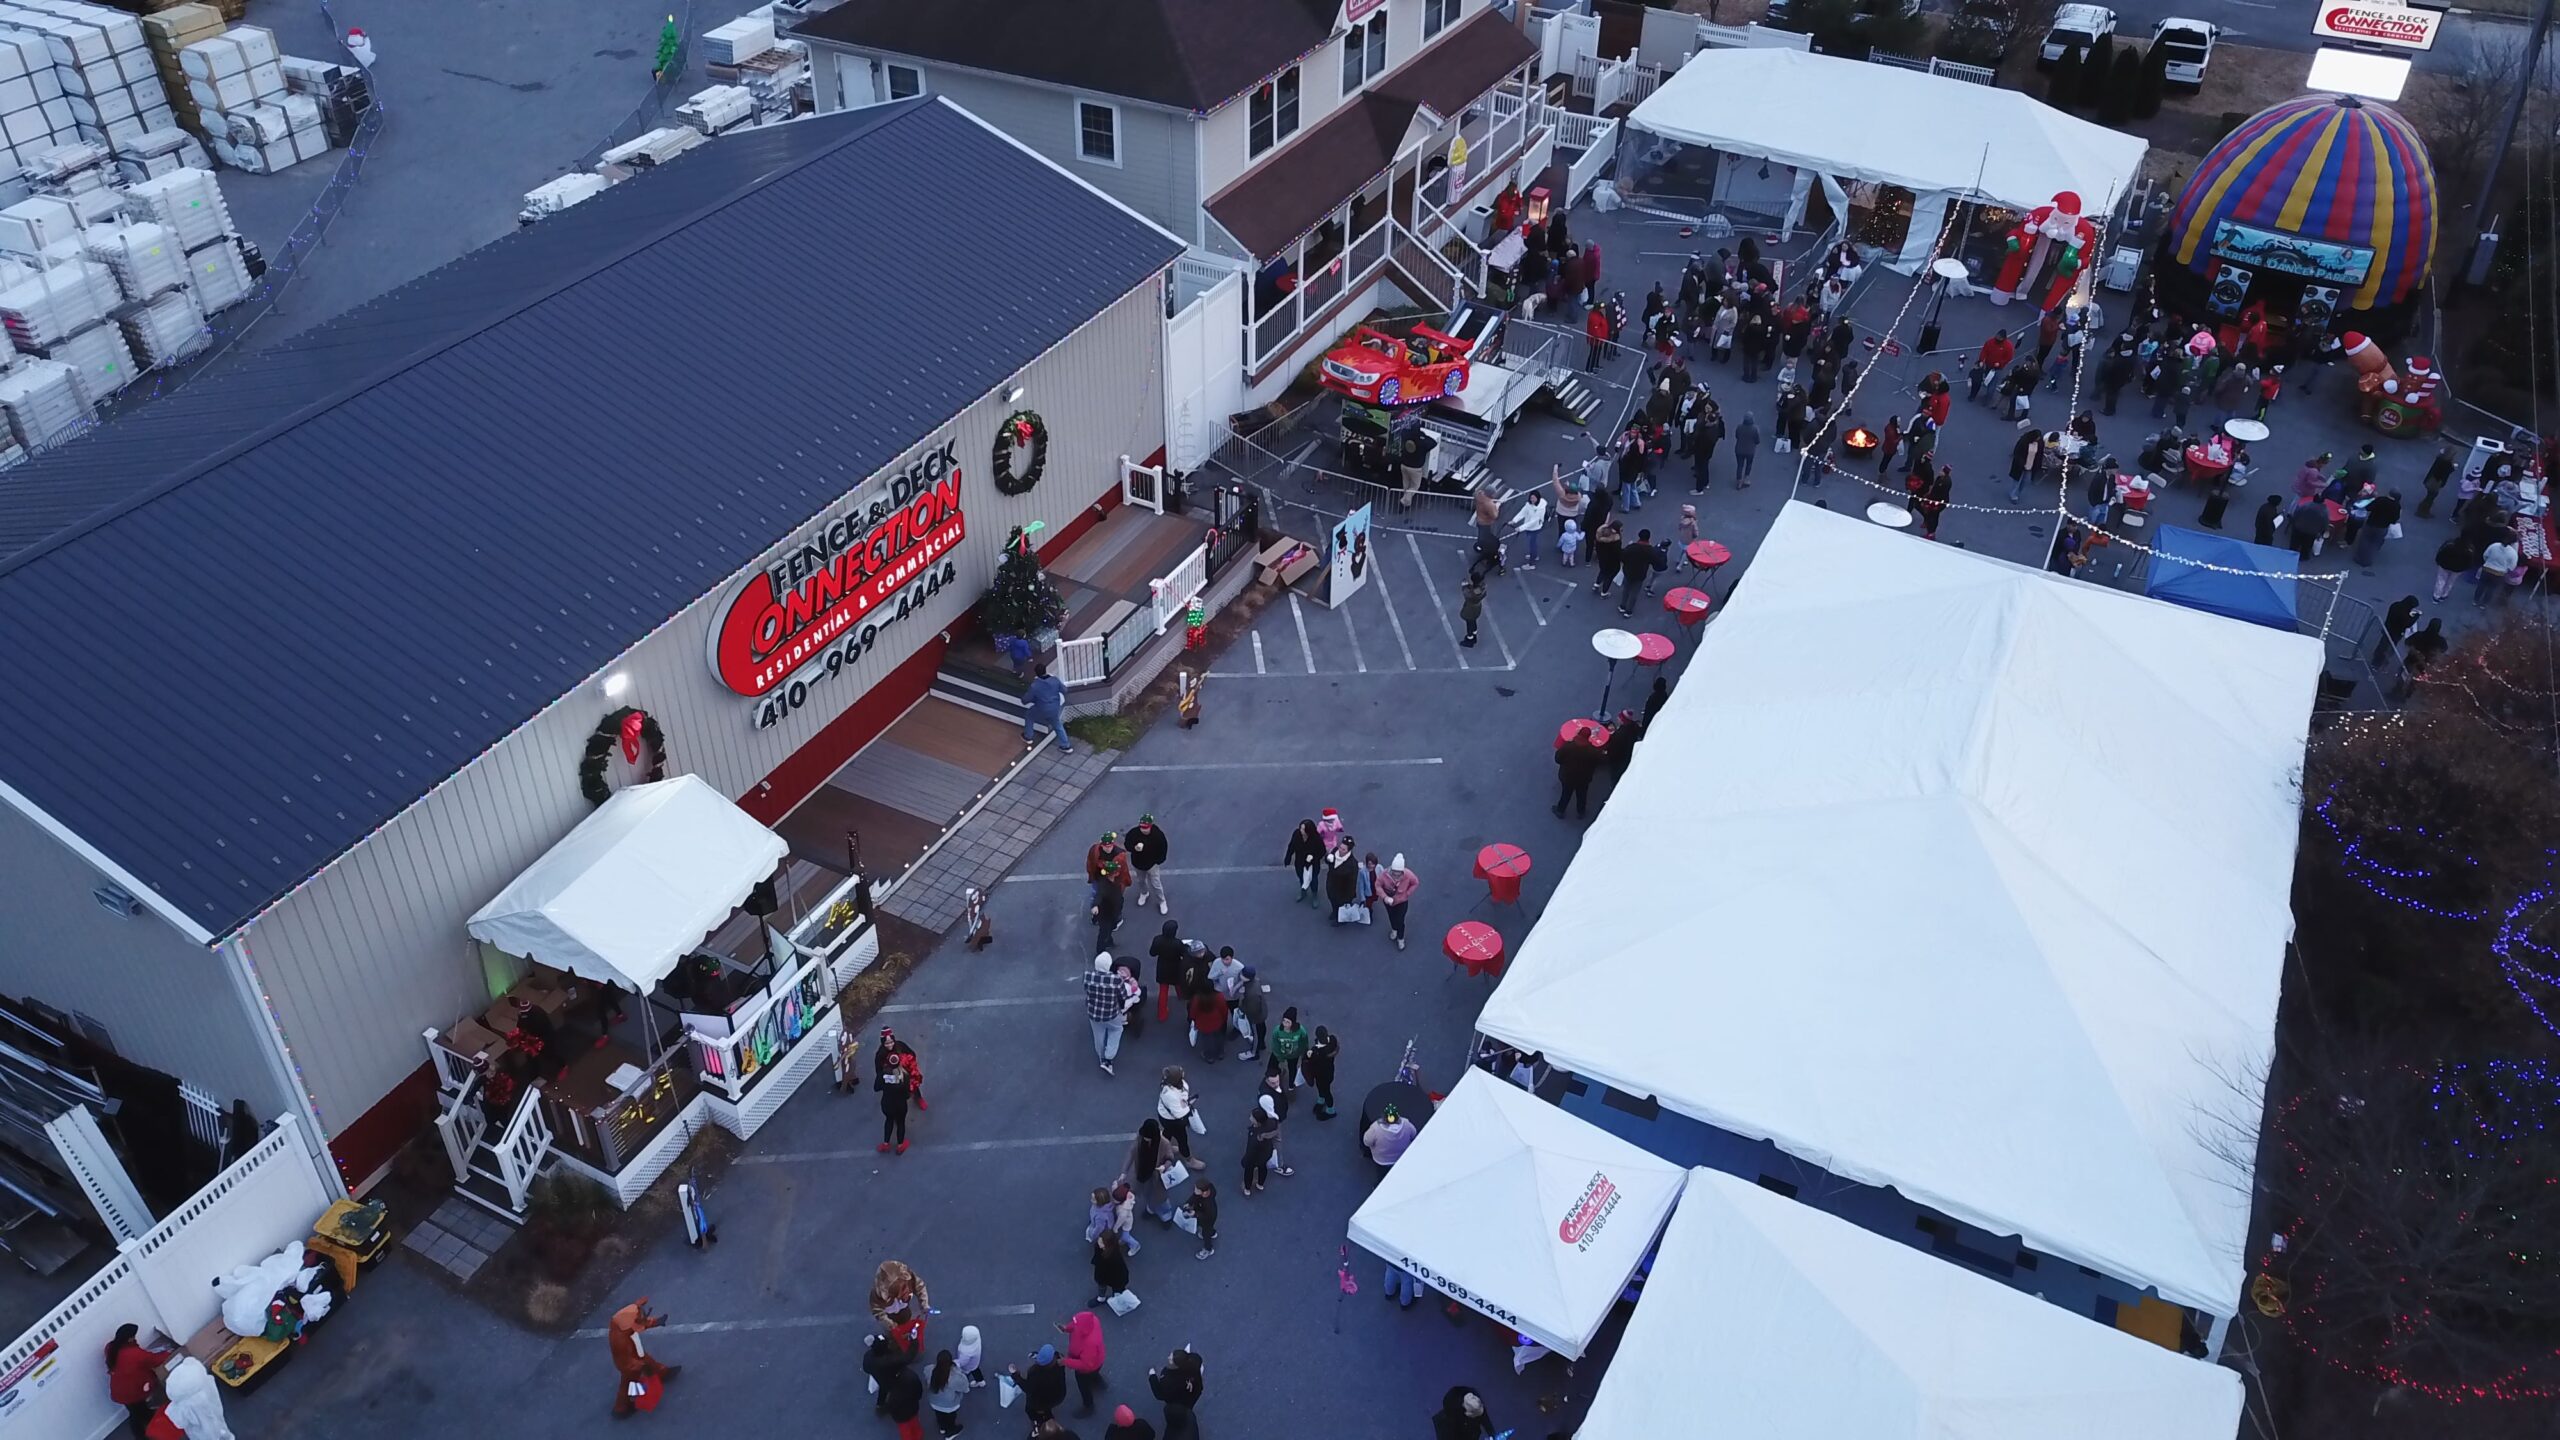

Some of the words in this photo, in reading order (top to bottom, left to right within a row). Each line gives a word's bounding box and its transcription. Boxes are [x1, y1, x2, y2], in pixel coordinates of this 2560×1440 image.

[2325, 8, 2429, 36] CONNECTION
[2349, 8, 2385, 20] FENCE
[2397, 15, 2430, 24] DECK
[2267, 258, 2311, 276] DANCE
[770, 508, 861, 597] FENCE
[868, 501, 886, 526] &
[887, 439, 960, 512] DECK
[715, 468, 963, 697] CONNECTION
[755, 608, 852, 690] RESIDENTIAL
[858, 595, 869, 610] &
[877, 523, 962, 595] COMMERCIAL
[756, 564, 957, 730] 410-969-4444
[1565, 1196, 1586, 1222] FENCE
[1587, 1170, 1603, 1192] DECK
[1578, 1191, 1622, 1253] 410-969-4444
[1399, 1256, 1518, 1326] 410-969-4444
